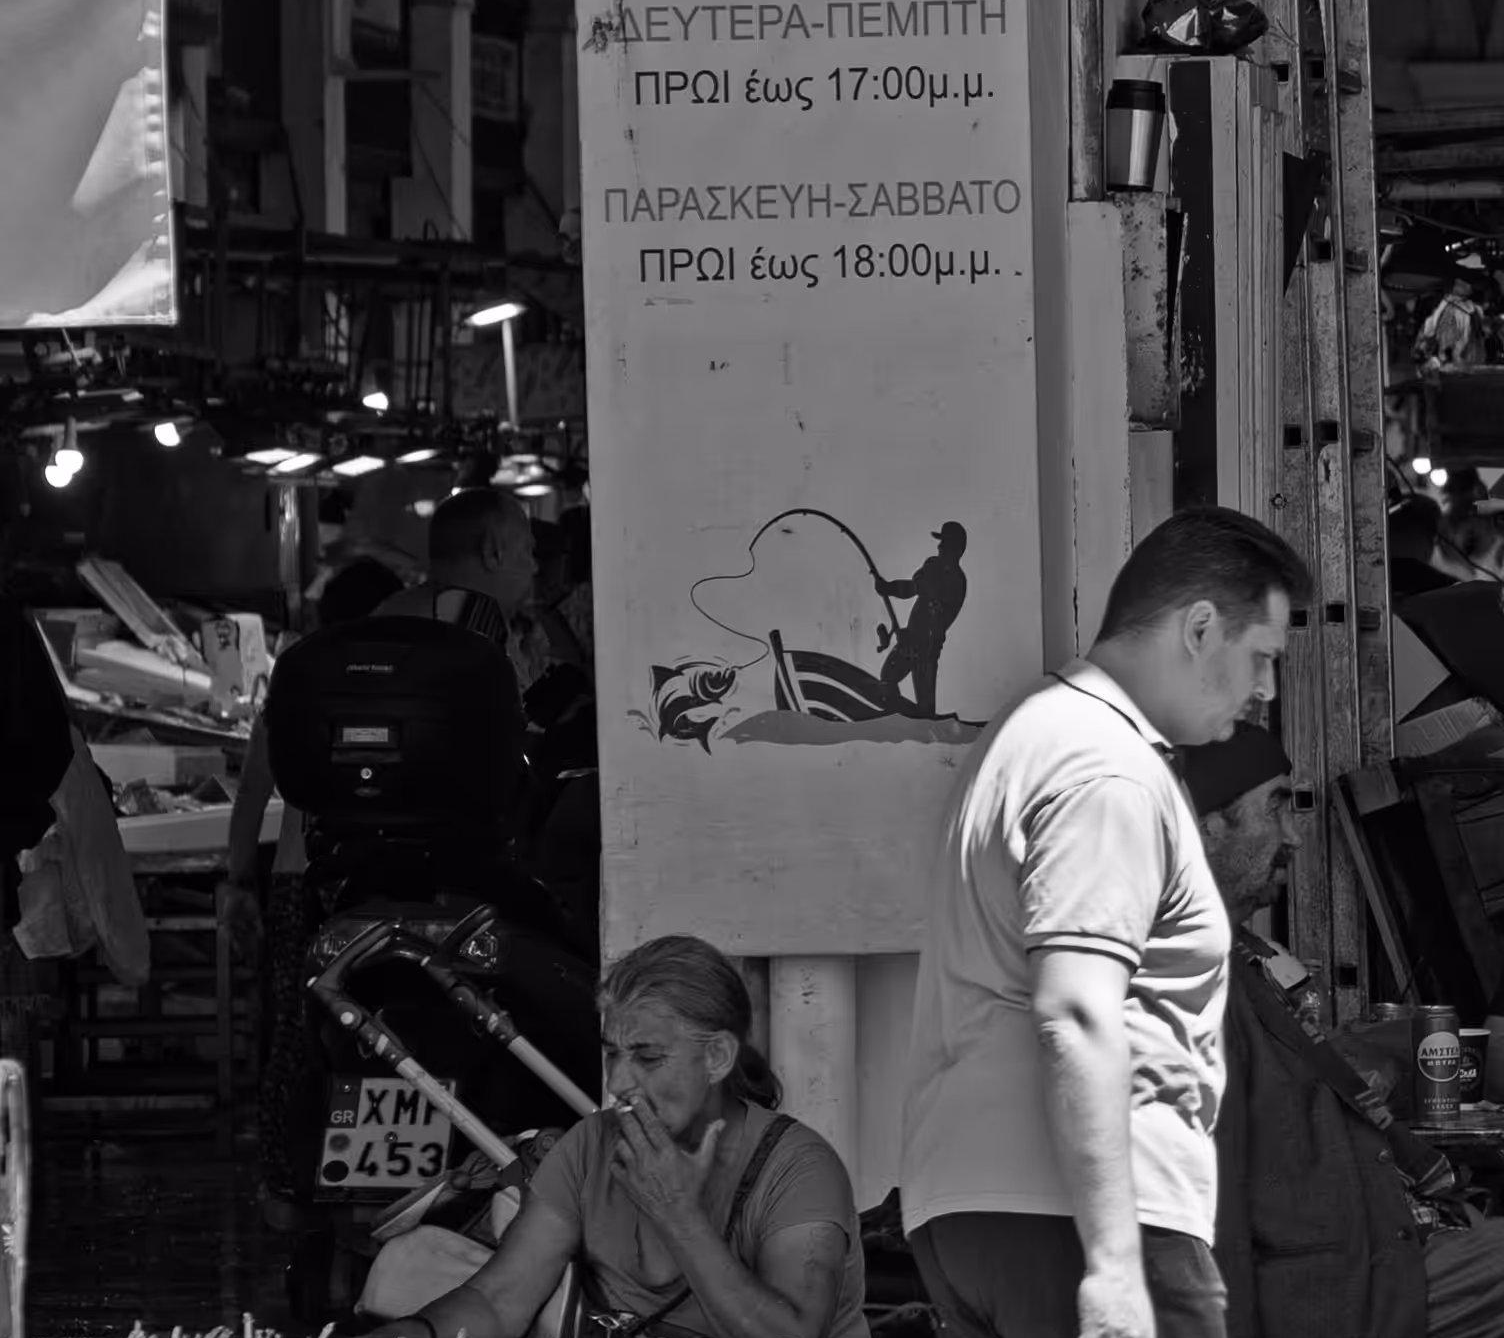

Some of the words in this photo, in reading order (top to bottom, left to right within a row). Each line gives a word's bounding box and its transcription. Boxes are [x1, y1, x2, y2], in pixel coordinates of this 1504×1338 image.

[634, 69, 729, 105] ΠΡΩΙ
[745, 68, 813, 111] έως
[827, 64, 994, 109] 17:00μ.μ.
[604, 178, 1021, 223] ΠΑΡΑΣΚΕΥΗ-ΣΑΒΒΑΤΟ
[639, 247, 735, 282] ΠΡΩΙ
[750, 246, 819, 288] έως
[832, 243, 1001, 286] 18:00μ.μ.
[330, 1110, 354, 1124] GR
[355, 1142, 443, 1178] 453
